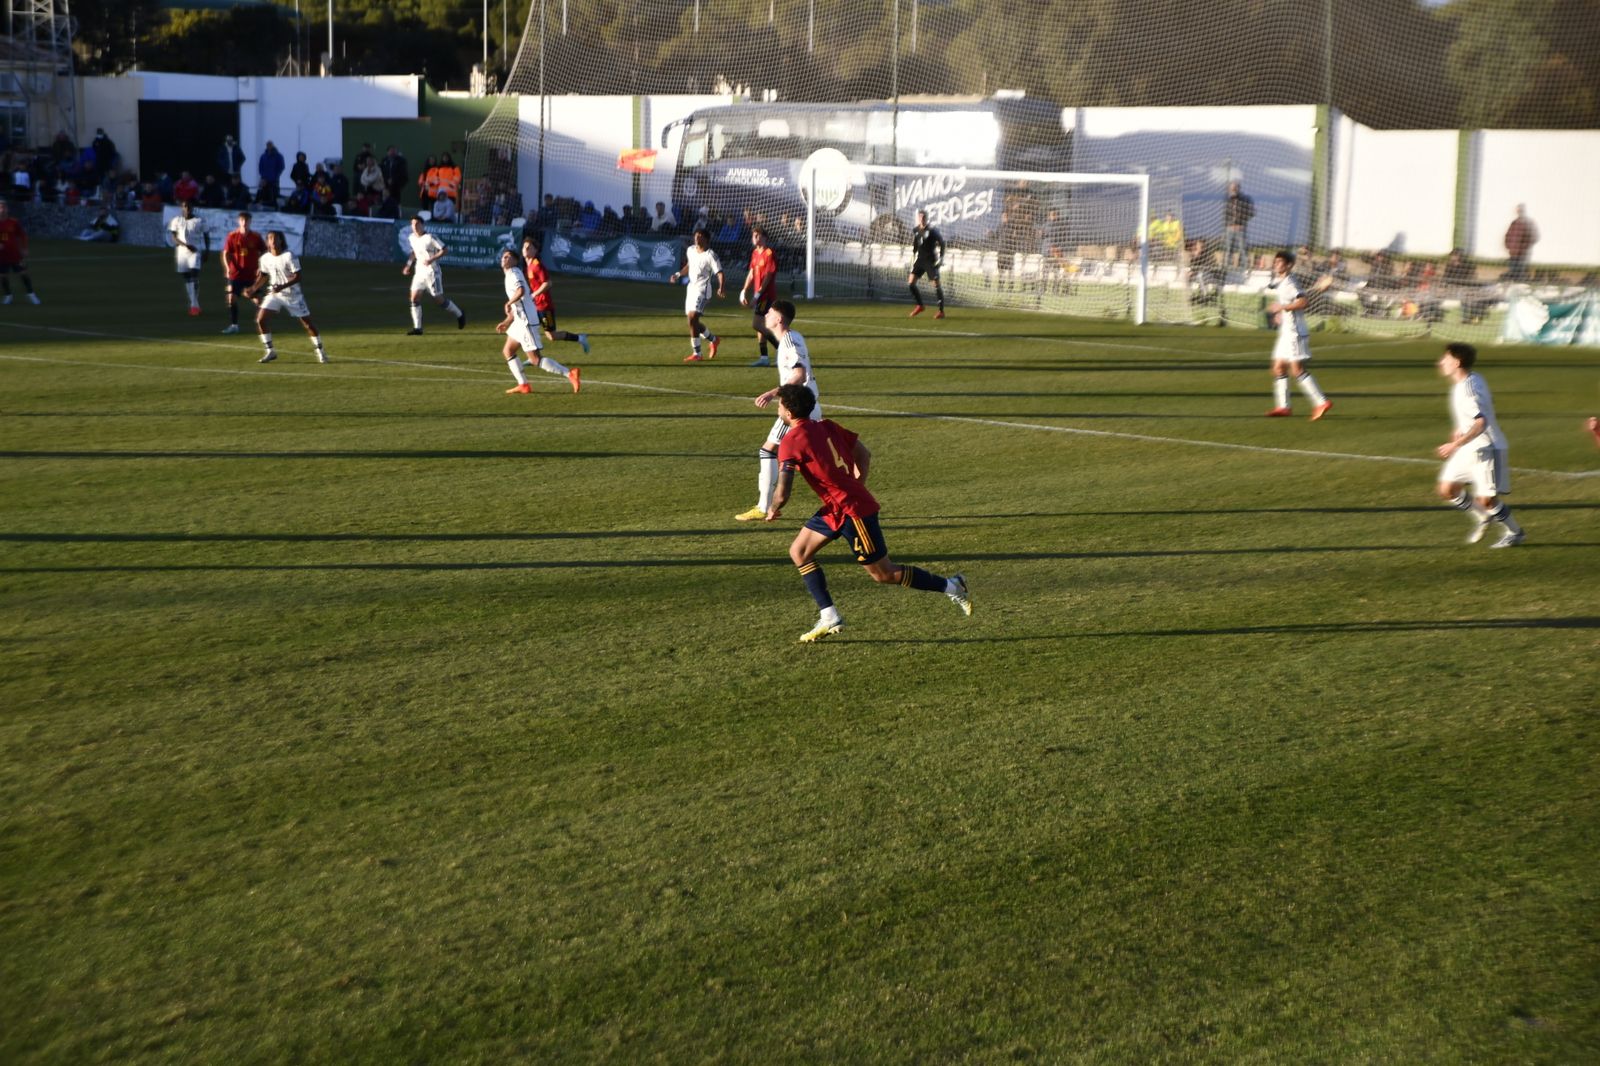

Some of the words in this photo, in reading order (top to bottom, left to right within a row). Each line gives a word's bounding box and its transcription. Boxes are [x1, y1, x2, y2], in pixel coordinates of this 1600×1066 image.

[727, 167, 769, 178] JUVENTUD
[771, 176, 787, 188] C.F.
[826, 437, 850, 475] 4
[853, 536, 865, 554] 4
